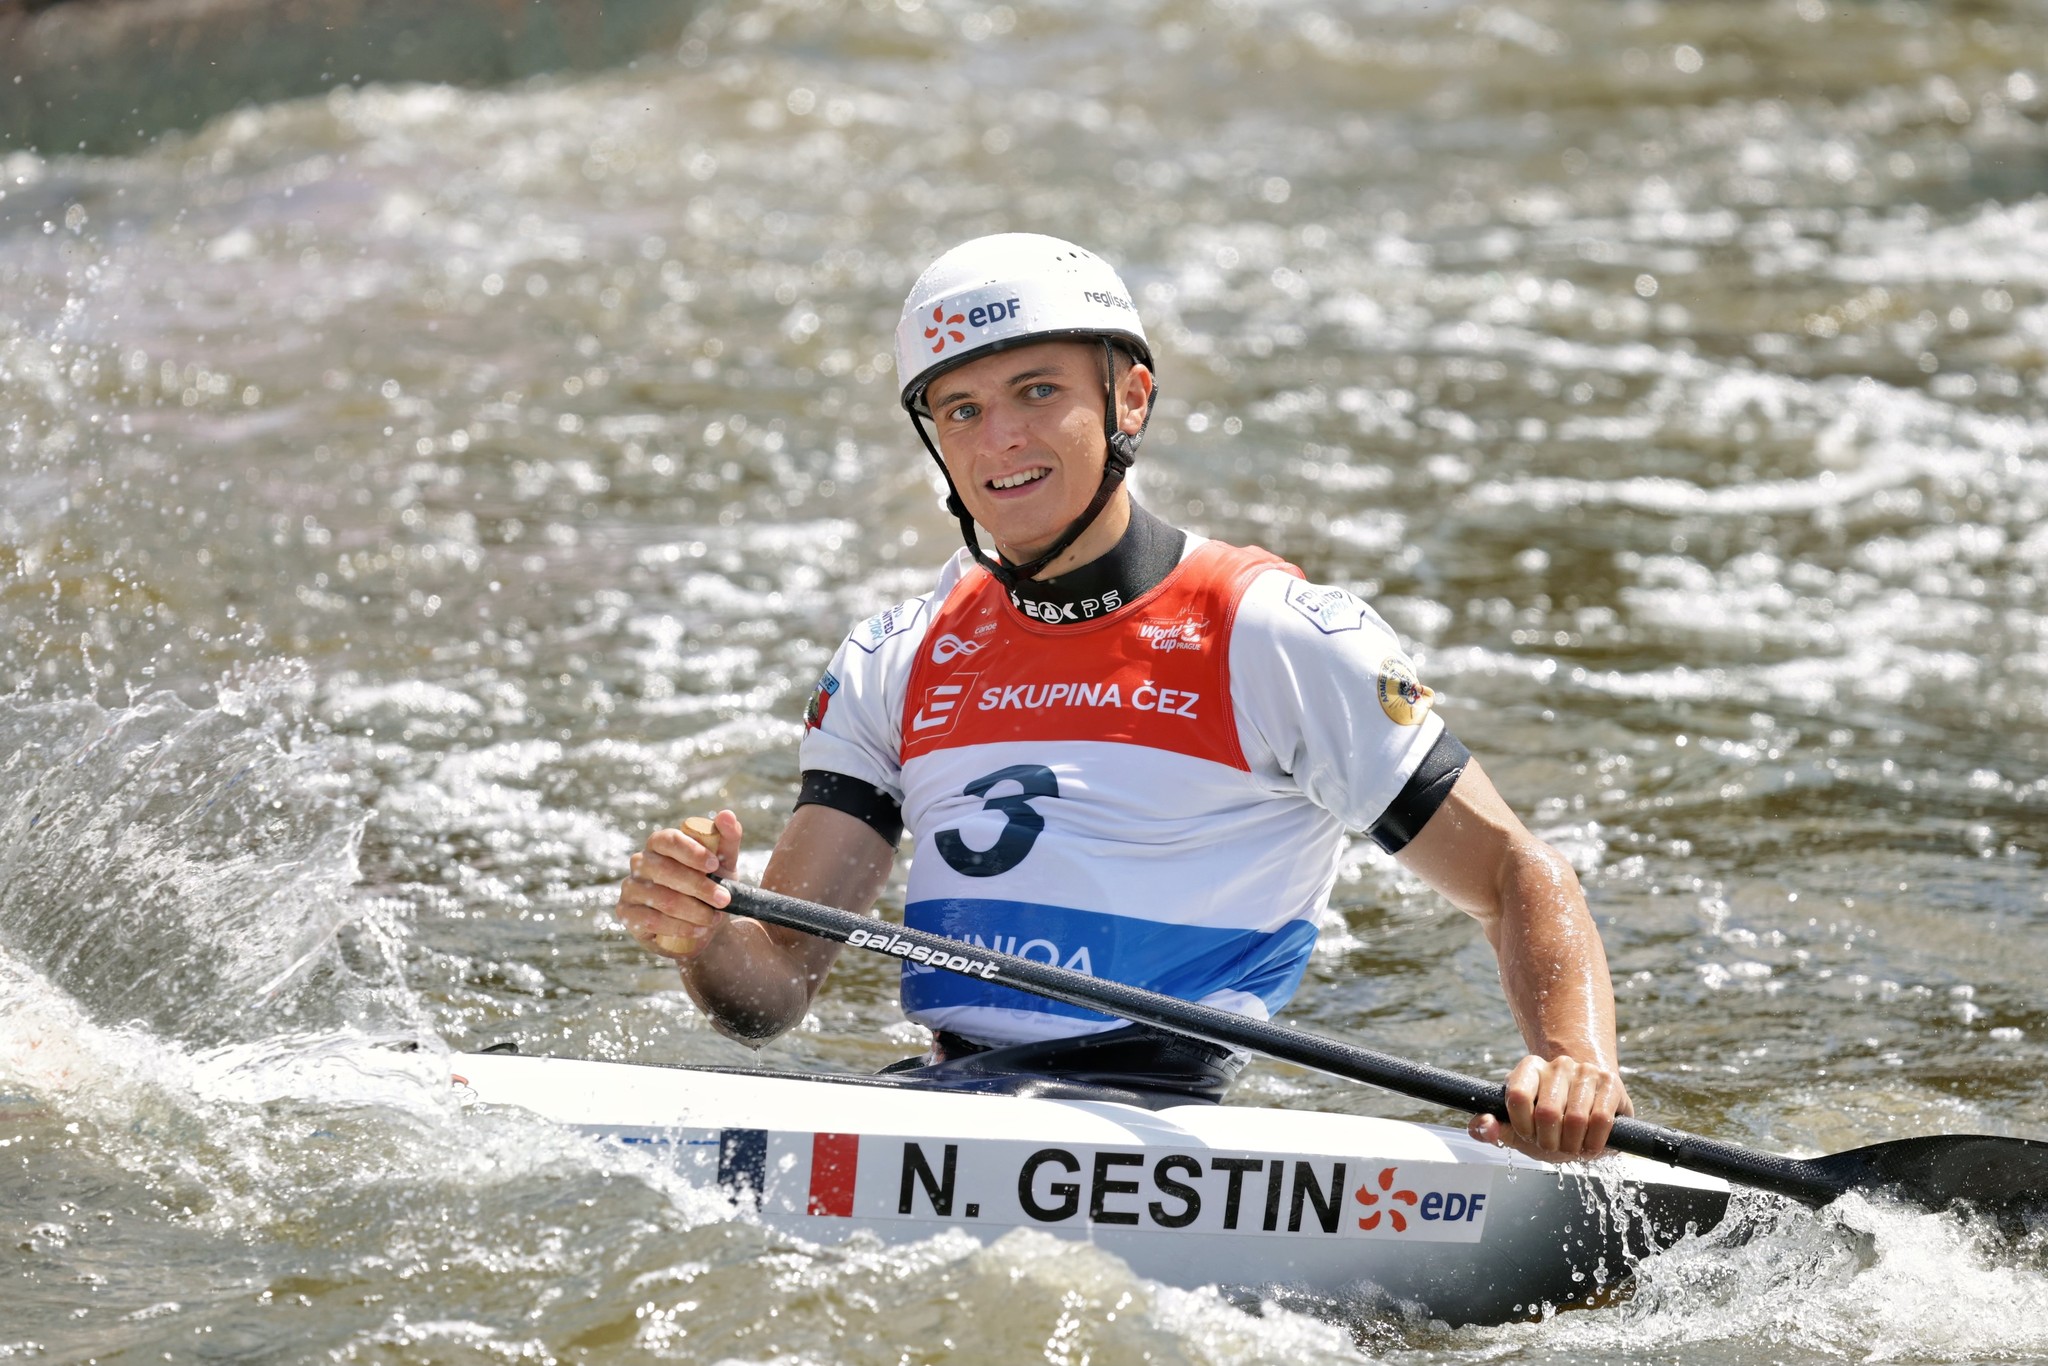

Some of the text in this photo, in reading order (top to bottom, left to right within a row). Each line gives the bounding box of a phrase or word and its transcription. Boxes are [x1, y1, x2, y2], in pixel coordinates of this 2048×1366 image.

[1139, 624, 1184, 639] World
[1151, 637, 1177, 654] Cup
[978, 680, 1200, 720] SKUPINA ČEZ
[934, 764, 1060, 878] 3
[845, 928, 1000, 980] galasport
[898, 1142, 981, 1218] N.
[1017, 1148, 1347, 1234] GESTIN
